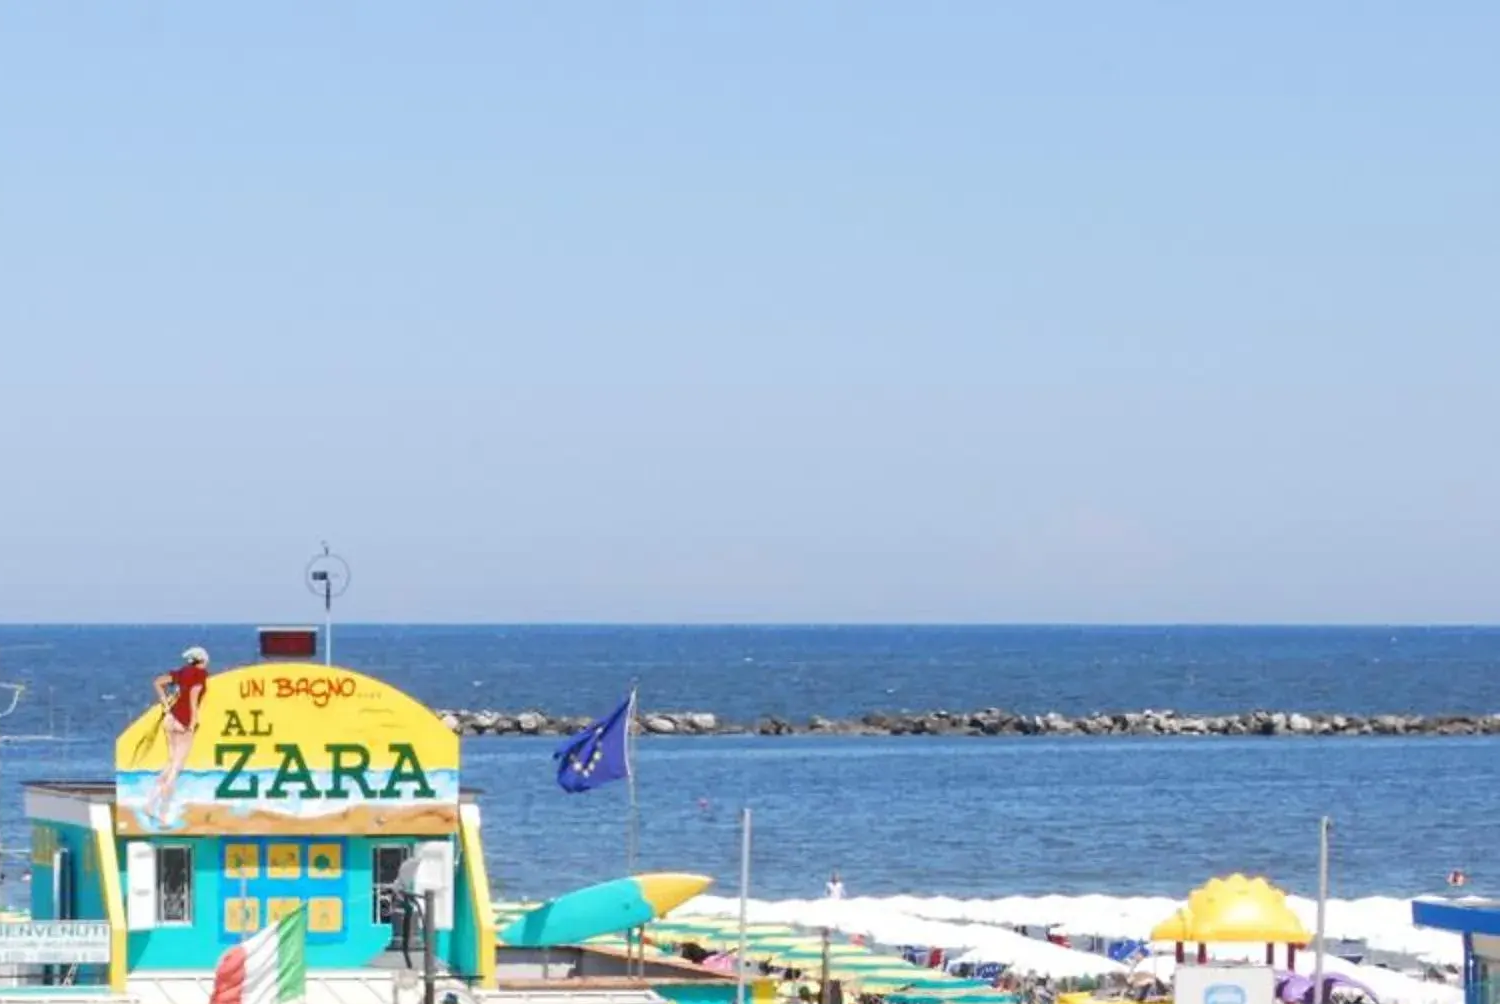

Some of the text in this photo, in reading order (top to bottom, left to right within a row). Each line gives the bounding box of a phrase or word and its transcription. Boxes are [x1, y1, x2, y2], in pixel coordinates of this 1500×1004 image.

[239, 679, 264, 698] UN
[220, 710, 273, 737] AL
[214, 743, 436, 799] ZARA
